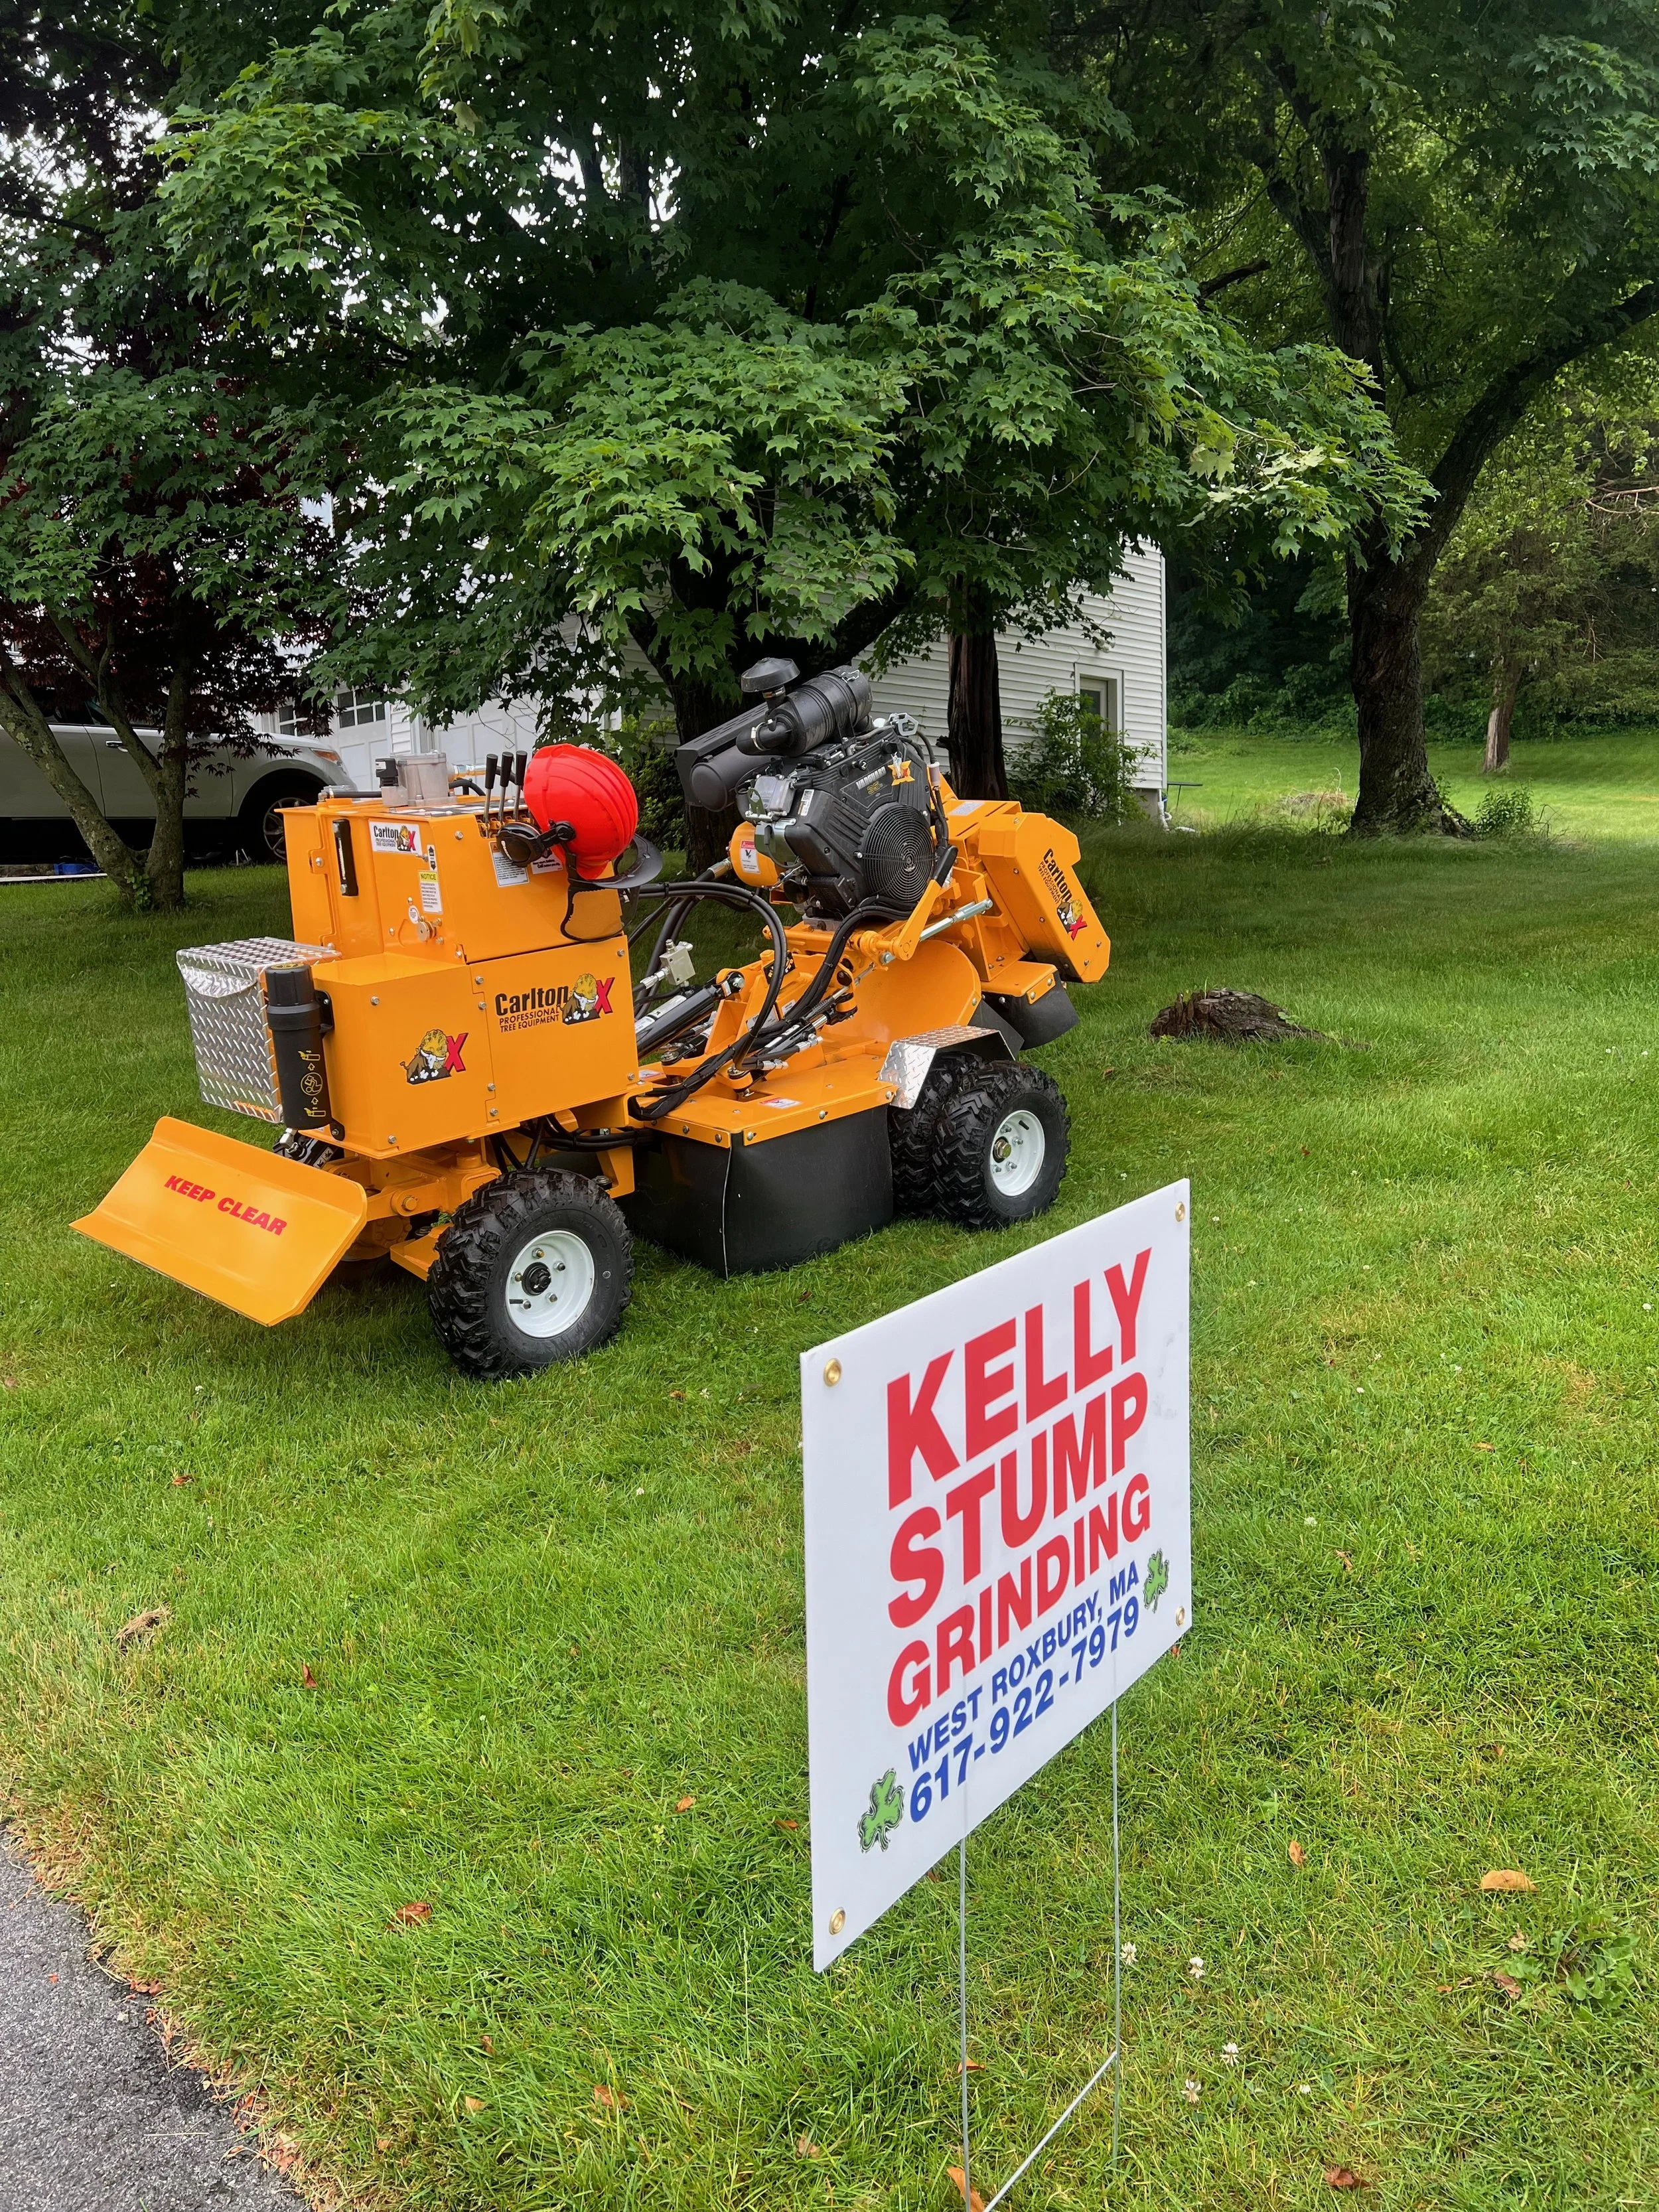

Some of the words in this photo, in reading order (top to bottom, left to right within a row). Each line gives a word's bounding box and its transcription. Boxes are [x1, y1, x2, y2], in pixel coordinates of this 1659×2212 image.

[855, 766, 887, 790] VANGUARD
[867, 781, 881, 795] 35
[374, 825, 398, 840] Carlton
[1041, 861, 1063, 903] PROFESSIONAL
[1043, 848, 1072, 903] Carlton
[1043, 876, 1060, 905] EQUIPMENT
[495, 986, 569, 1016] Carlton
[499, 1007, 559, 1026] PROFESSIONAL
[518, 1014, 559, 1029] EQUIPMENT
[165, 1175, 216, 1203] KEEP
[218, 1197, 287, 1236] CLEAR
[887, 1248, 1152, 1511] KELLY
[887, 1372, 1149, 1629] STUMP
[887, 1473, 1151, 1728] GRINDING
[908, 1684, 984, 1773] WEST
[991, 1590, 1104, 1706] ROXBURY,
[1109, 1561, 1139, 1607] MA
[909, 1595, 1140, 1824] 617-922-7979
